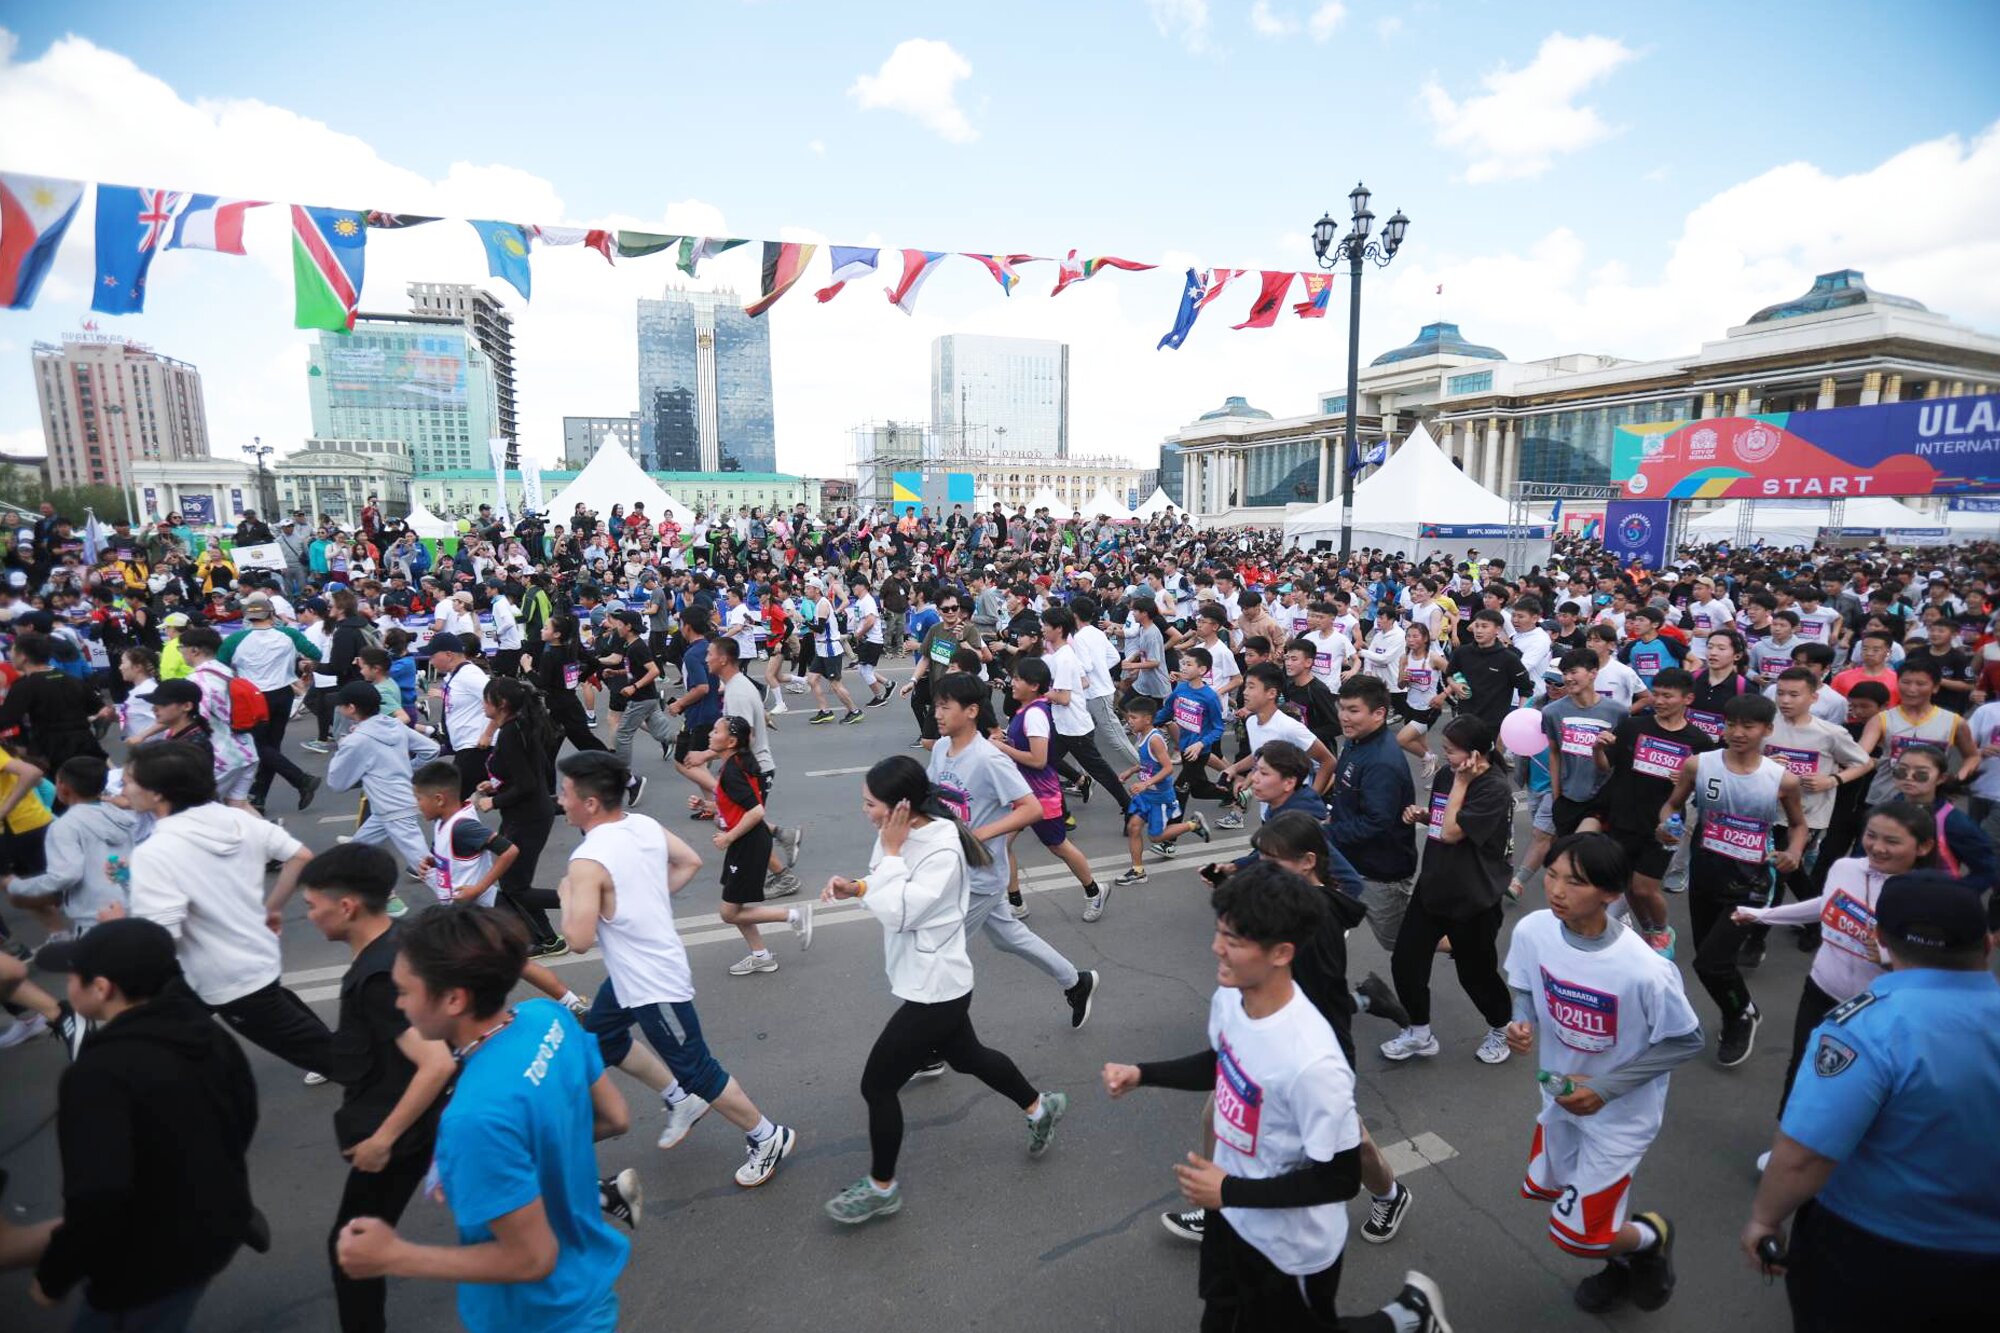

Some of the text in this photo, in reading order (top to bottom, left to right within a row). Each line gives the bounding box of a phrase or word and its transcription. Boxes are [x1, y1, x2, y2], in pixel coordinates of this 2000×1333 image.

[1763, 476, 1874, 495] START
[1649, 750, 1682, 768] 03367
[1706, 777, 1722, 799] 5
[1723, 828, 1763, 849] 02504
[1555, 1001, 1608, 1034] 02411
[1556, 1184, 1579, 1218] 3
